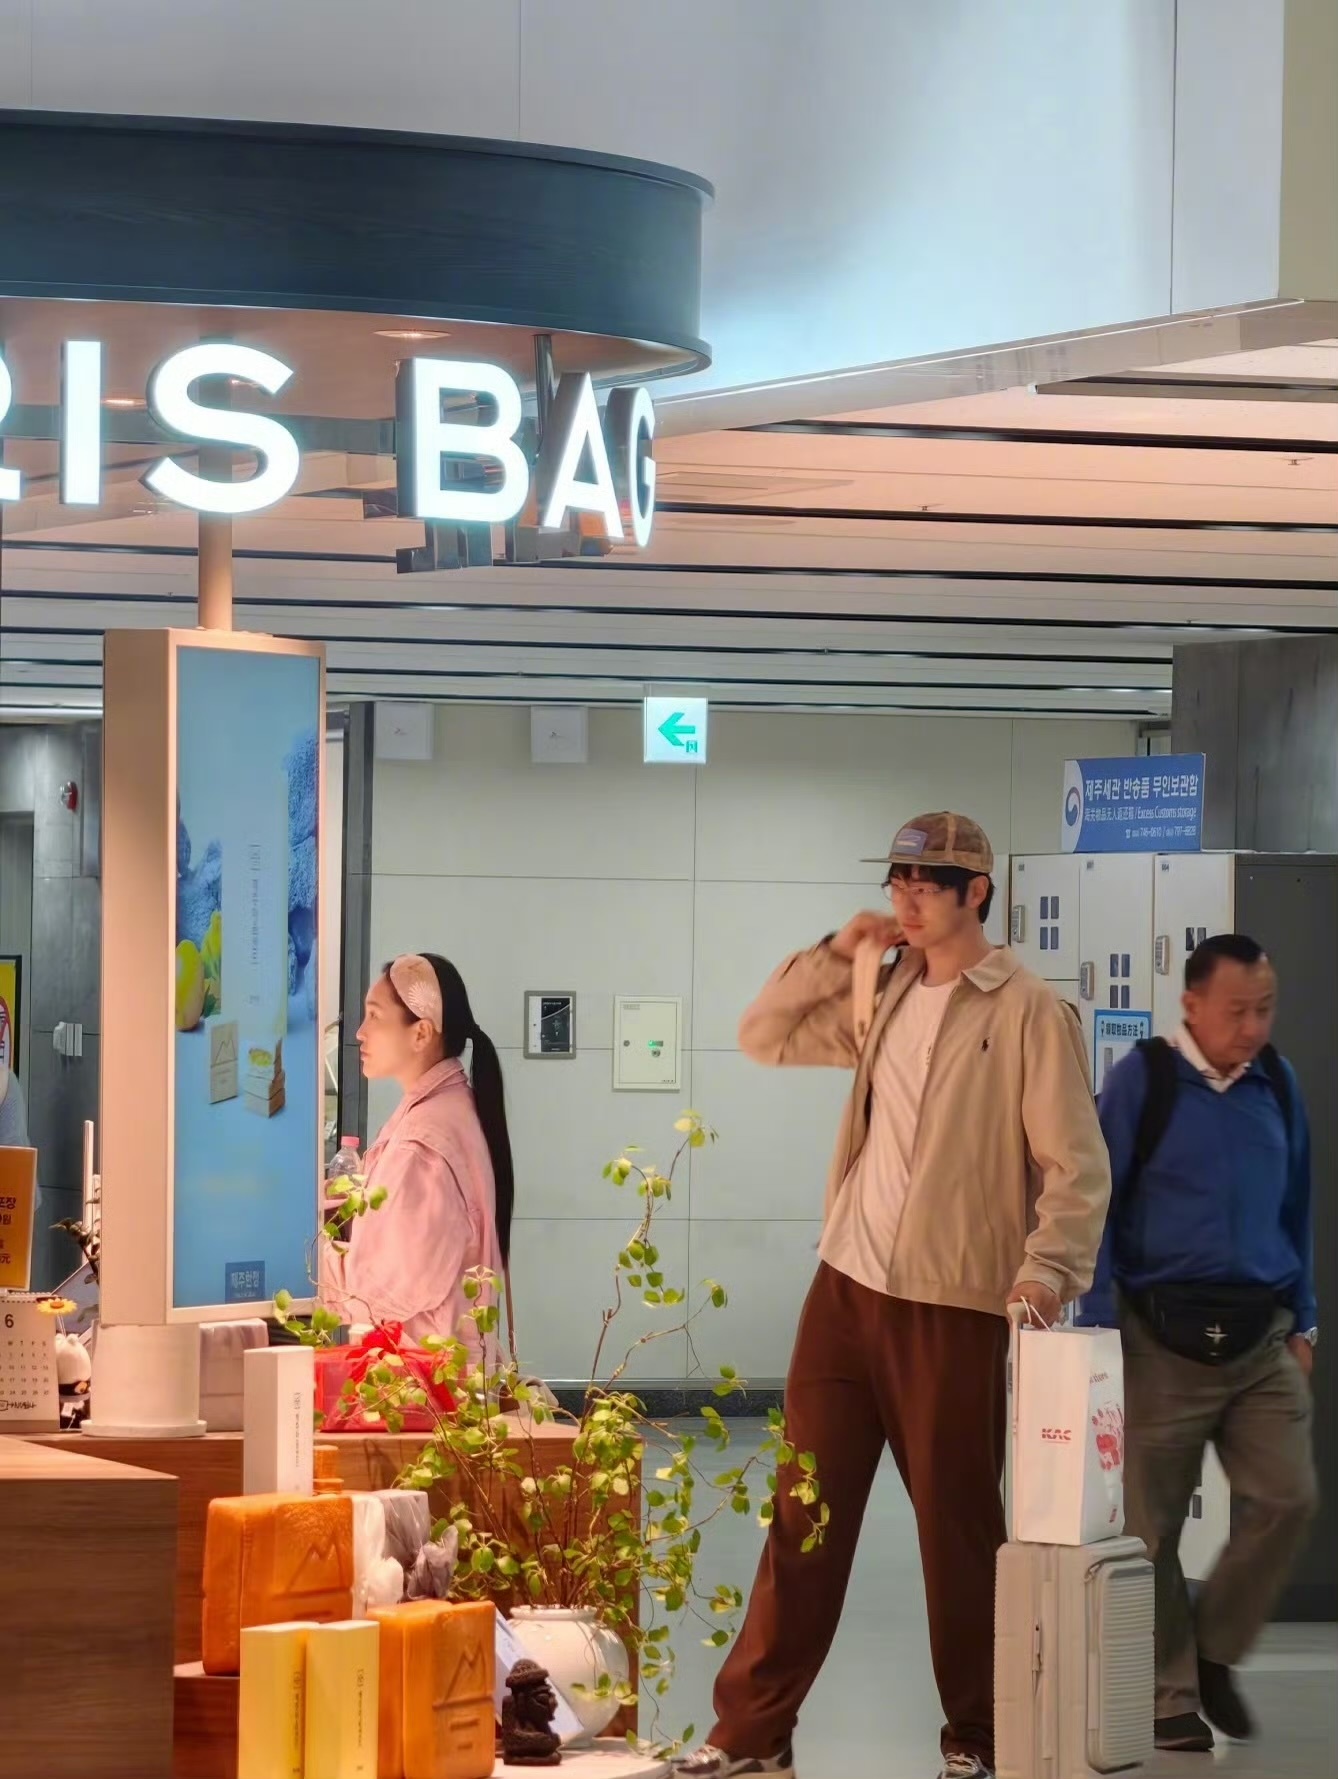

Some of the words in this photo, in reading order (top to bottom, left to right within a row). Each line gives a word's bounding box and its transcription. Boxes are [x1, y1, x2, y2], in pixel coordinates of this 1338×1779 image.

[412, 356, 656, 548] BAG
[1085, 778, 1120, 801] 제주세관
[1123, 777, 1150, 800] 반송품
[1153, 774, 1198, 798] 무인보관함
[1155, 805, 1177, 819] Customs
[1177, 806, 1197, 821] storage
[5, 1313, 14, 1328] 6
